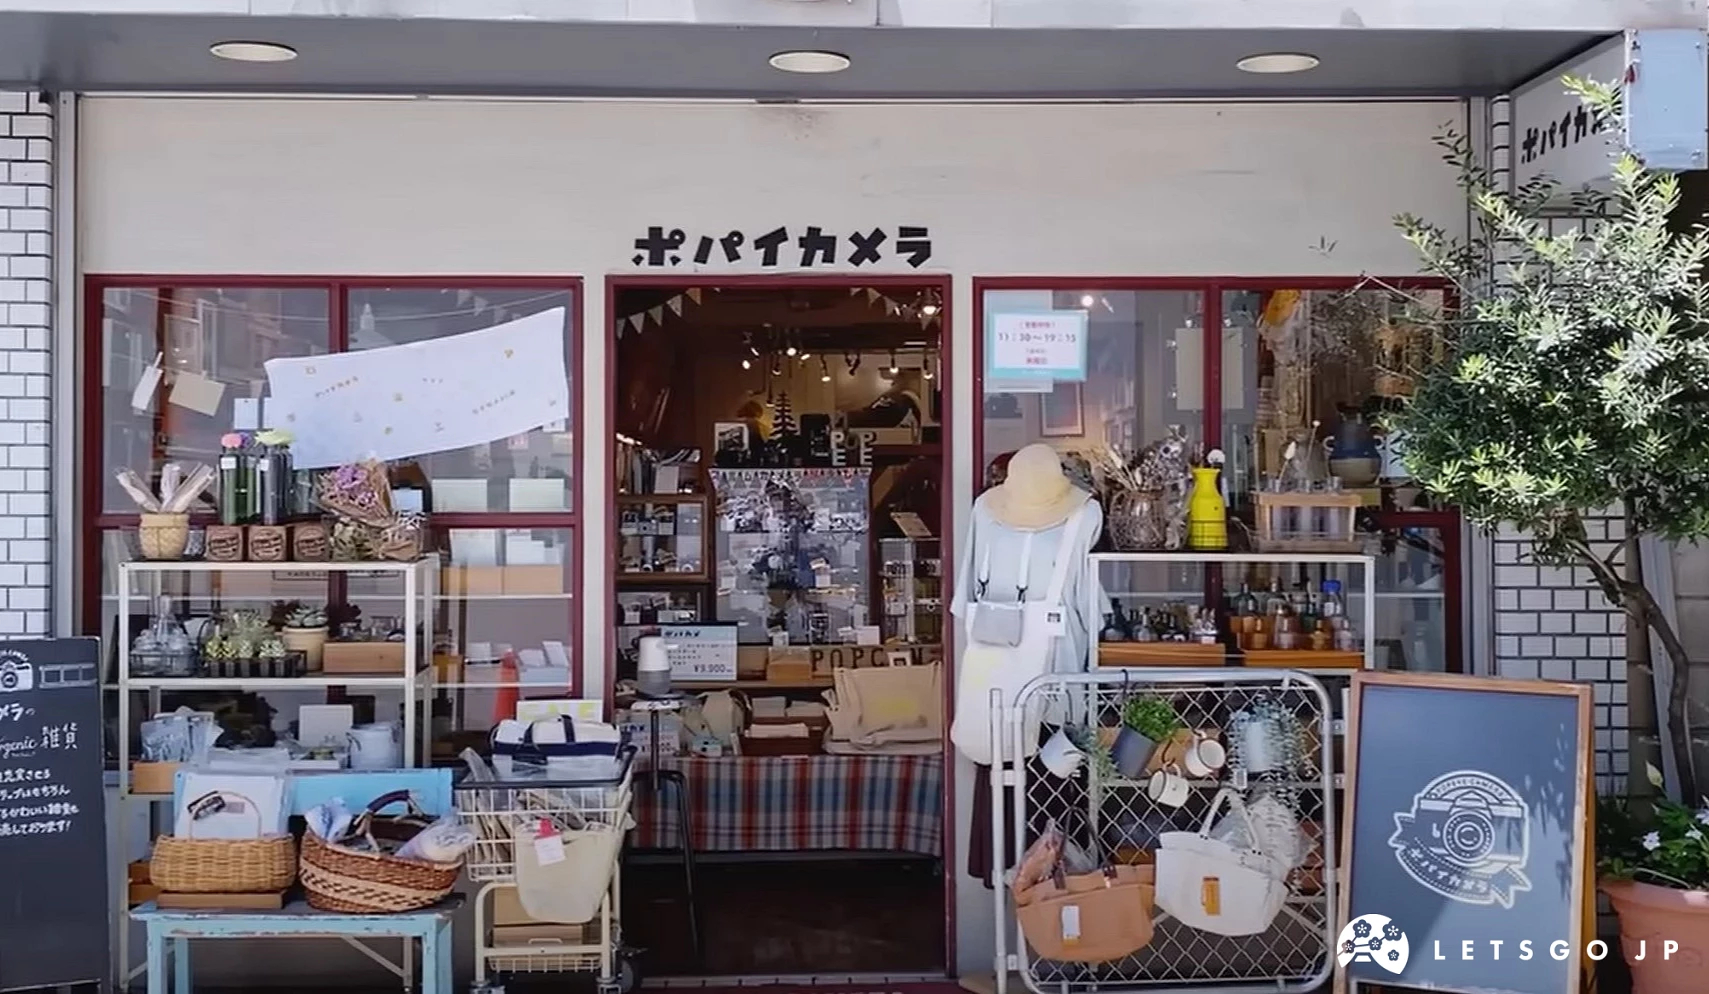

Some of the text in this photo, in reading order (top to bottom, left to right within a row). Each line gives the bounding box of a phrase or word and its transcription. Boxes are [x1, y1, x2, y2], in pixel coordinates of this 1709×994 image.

[632, 226, 932, 268] ポパイカメラ
[40, 722, 78, 750] 雑貨
[1409, 846, 1490, 894] ポパイカメラ
